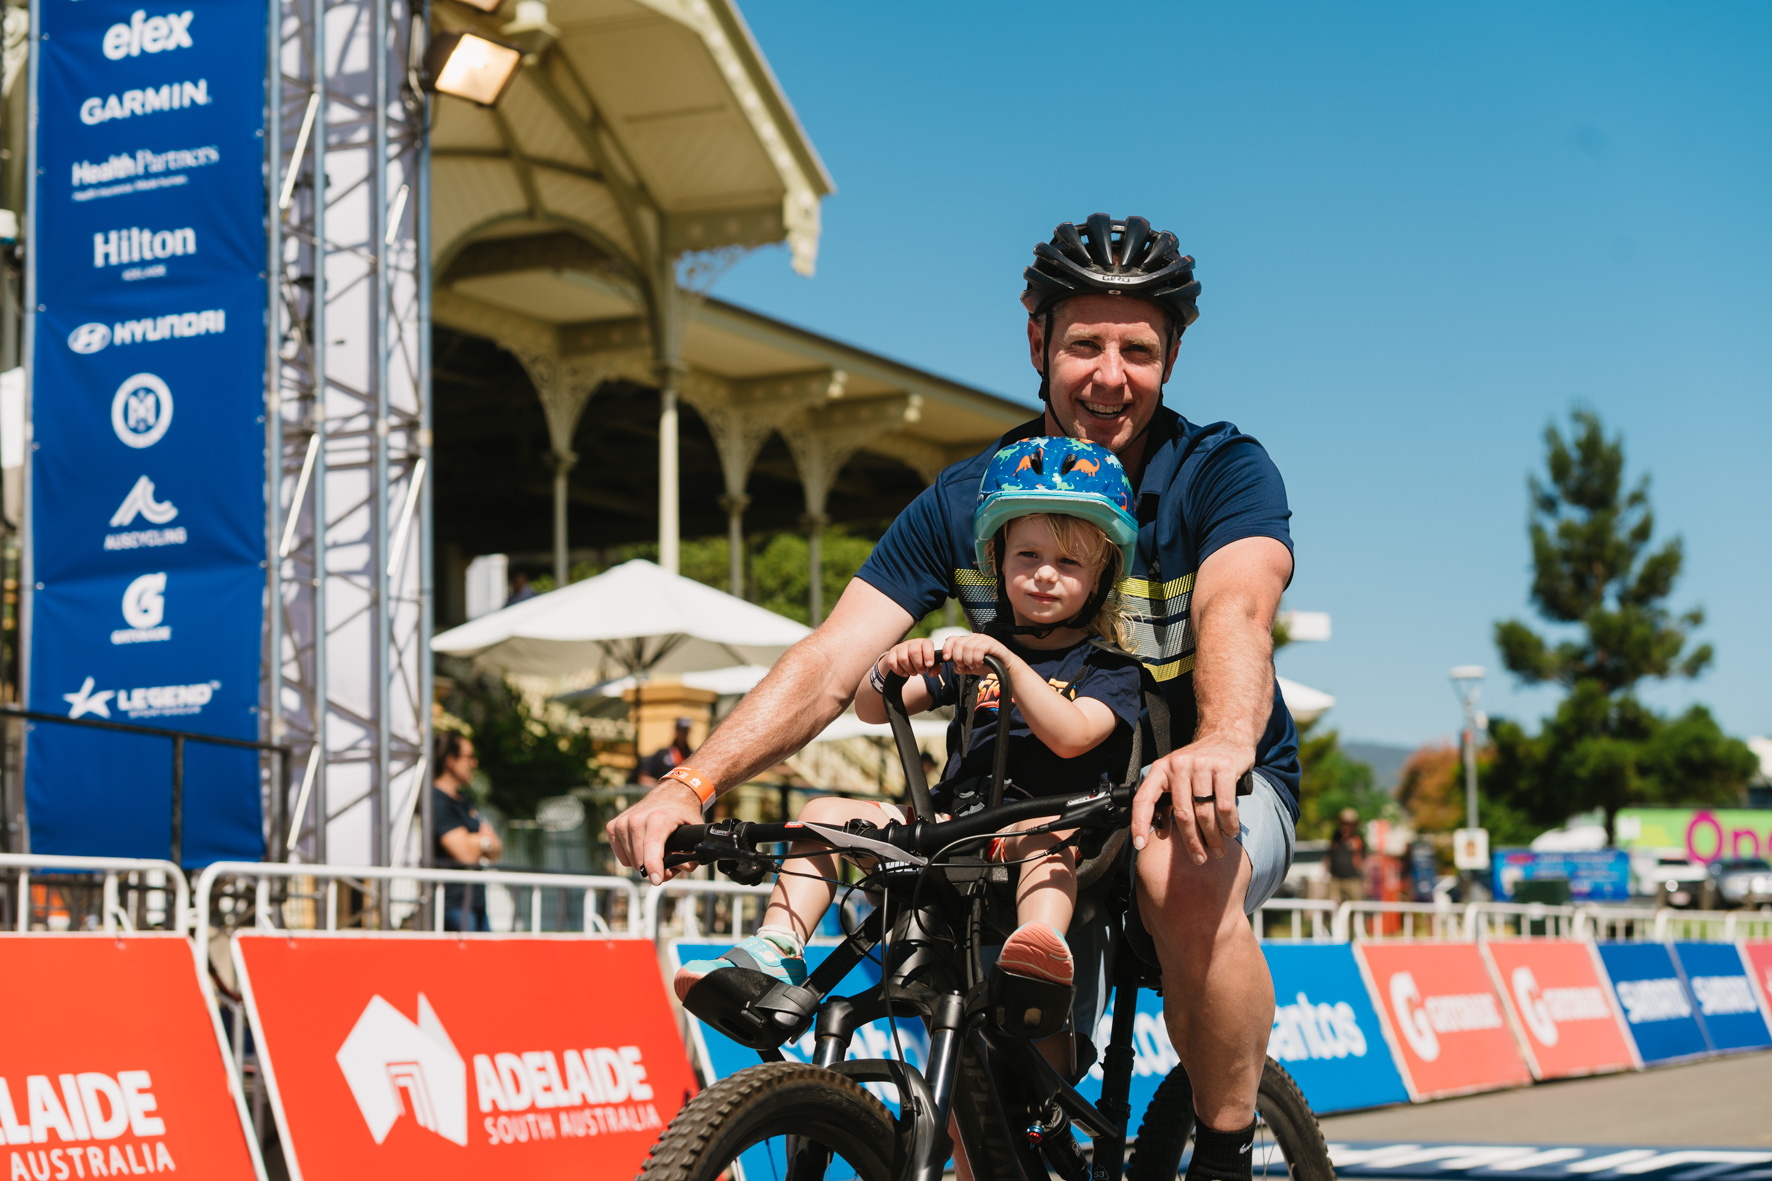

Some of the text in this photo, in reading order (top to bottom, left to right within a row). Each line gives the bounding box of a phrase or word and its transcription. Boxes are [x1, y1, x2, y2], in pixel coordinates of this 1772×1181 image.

[80, 78, 209, 126] GARMIN
[94, 226, 197, 268] Hilton
[113, 309, 226, 346] HYUNDAI
[117, 682, 213, 711] LEGEND
[1687, 810, 1772, 866] On
[1264, 991, 1367, 1063] antos
[473, 1045, 655, 1113] ADELAIDE
[0, 1070, 166, 1146] LAIDE
[484, 1102, 663, 1146] SOUTH AUSTRALIA
[10, 1141, 177, 1181] AUSTRALIA
